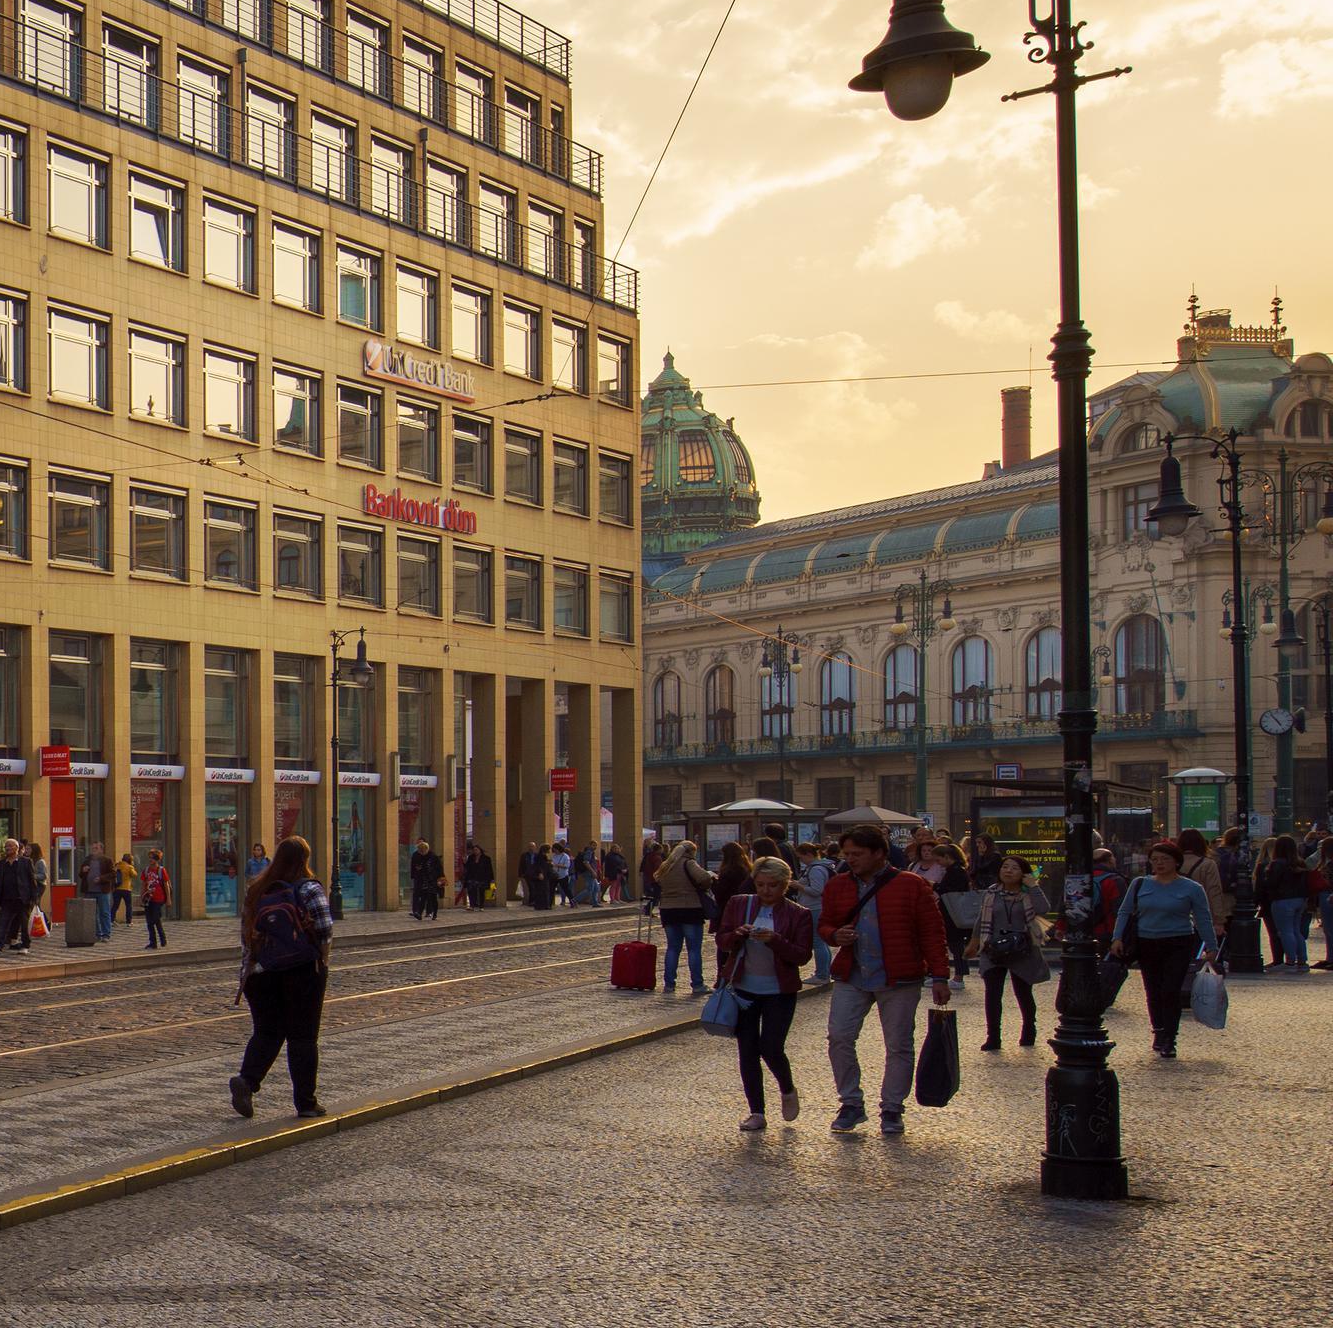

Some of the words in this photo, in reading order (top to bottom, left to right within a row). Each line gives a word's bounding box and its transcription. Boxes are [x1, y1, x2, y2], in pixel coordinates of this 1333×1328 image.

[382, 344, 442, 386] UniCredit
[443, 362, 475, 394] Bank
[364, 483, 441, 527] Bankovní
[444, 498, 477, 534] dům
[0, 763, 12, 772] Bank
[70, 766, 83, 775] Credit
[84, 767, 95, 776] Bank
[143, 768, 162, 776] UniCredit
[162, 768, 173, 777] Bank
[234, 772, 244, 780] Bank
[1050, 819, 1065, 828] mi
